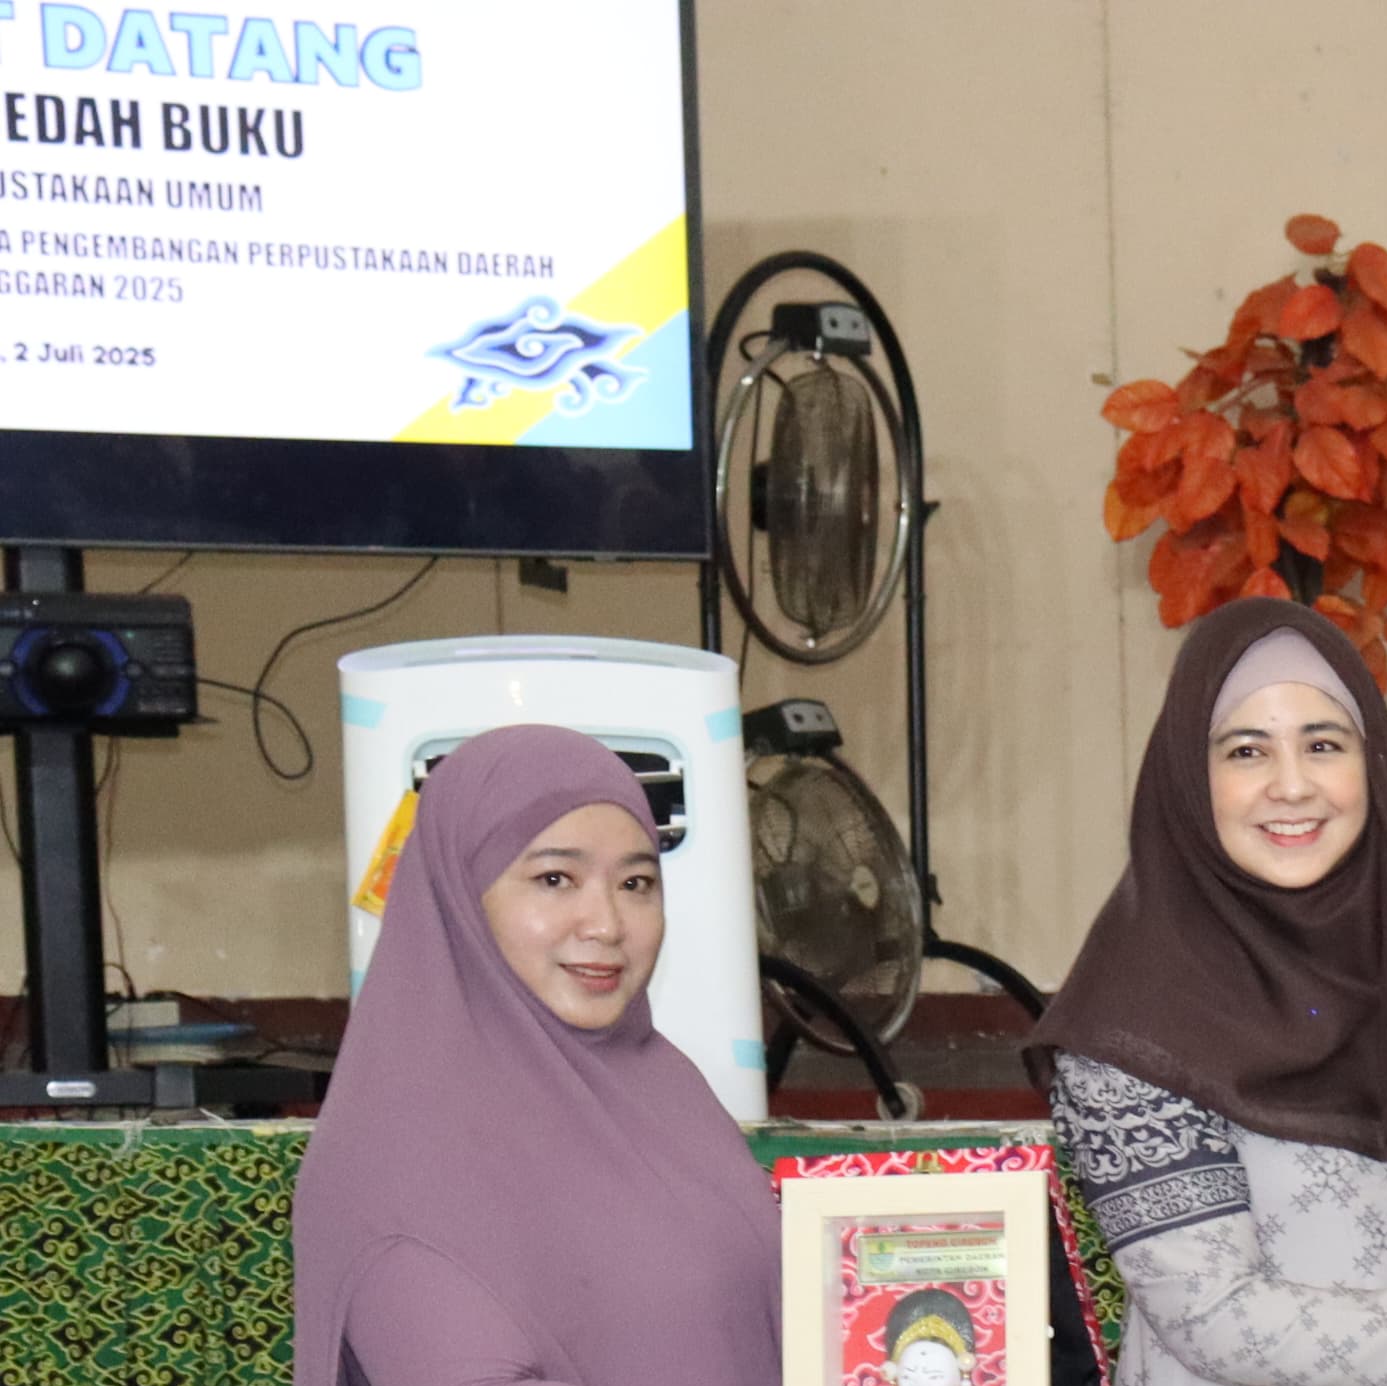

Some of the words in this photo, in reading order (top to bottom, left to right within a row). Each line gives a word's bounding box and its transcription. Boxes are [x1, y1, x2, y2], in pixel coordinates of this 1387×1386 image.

[40, 2, 422, 91] DATANG
[5, 92, 141, 148] EDAH
[162, 102, 304, 158] BUKU
[166, 180, 263, 212] UMUM
[21, 229, 239, 264] PENGEMBANGAN
[248, 242, 448, 273] PERPUSTAKAAN
[458, 252, 554, 278] DAERAH
[114, 274, 184, 303] 2025
[14, 341, 28, 361] 2
[37, 343, 84, 364] Juli
[93, 345, 157, 366] 2025
